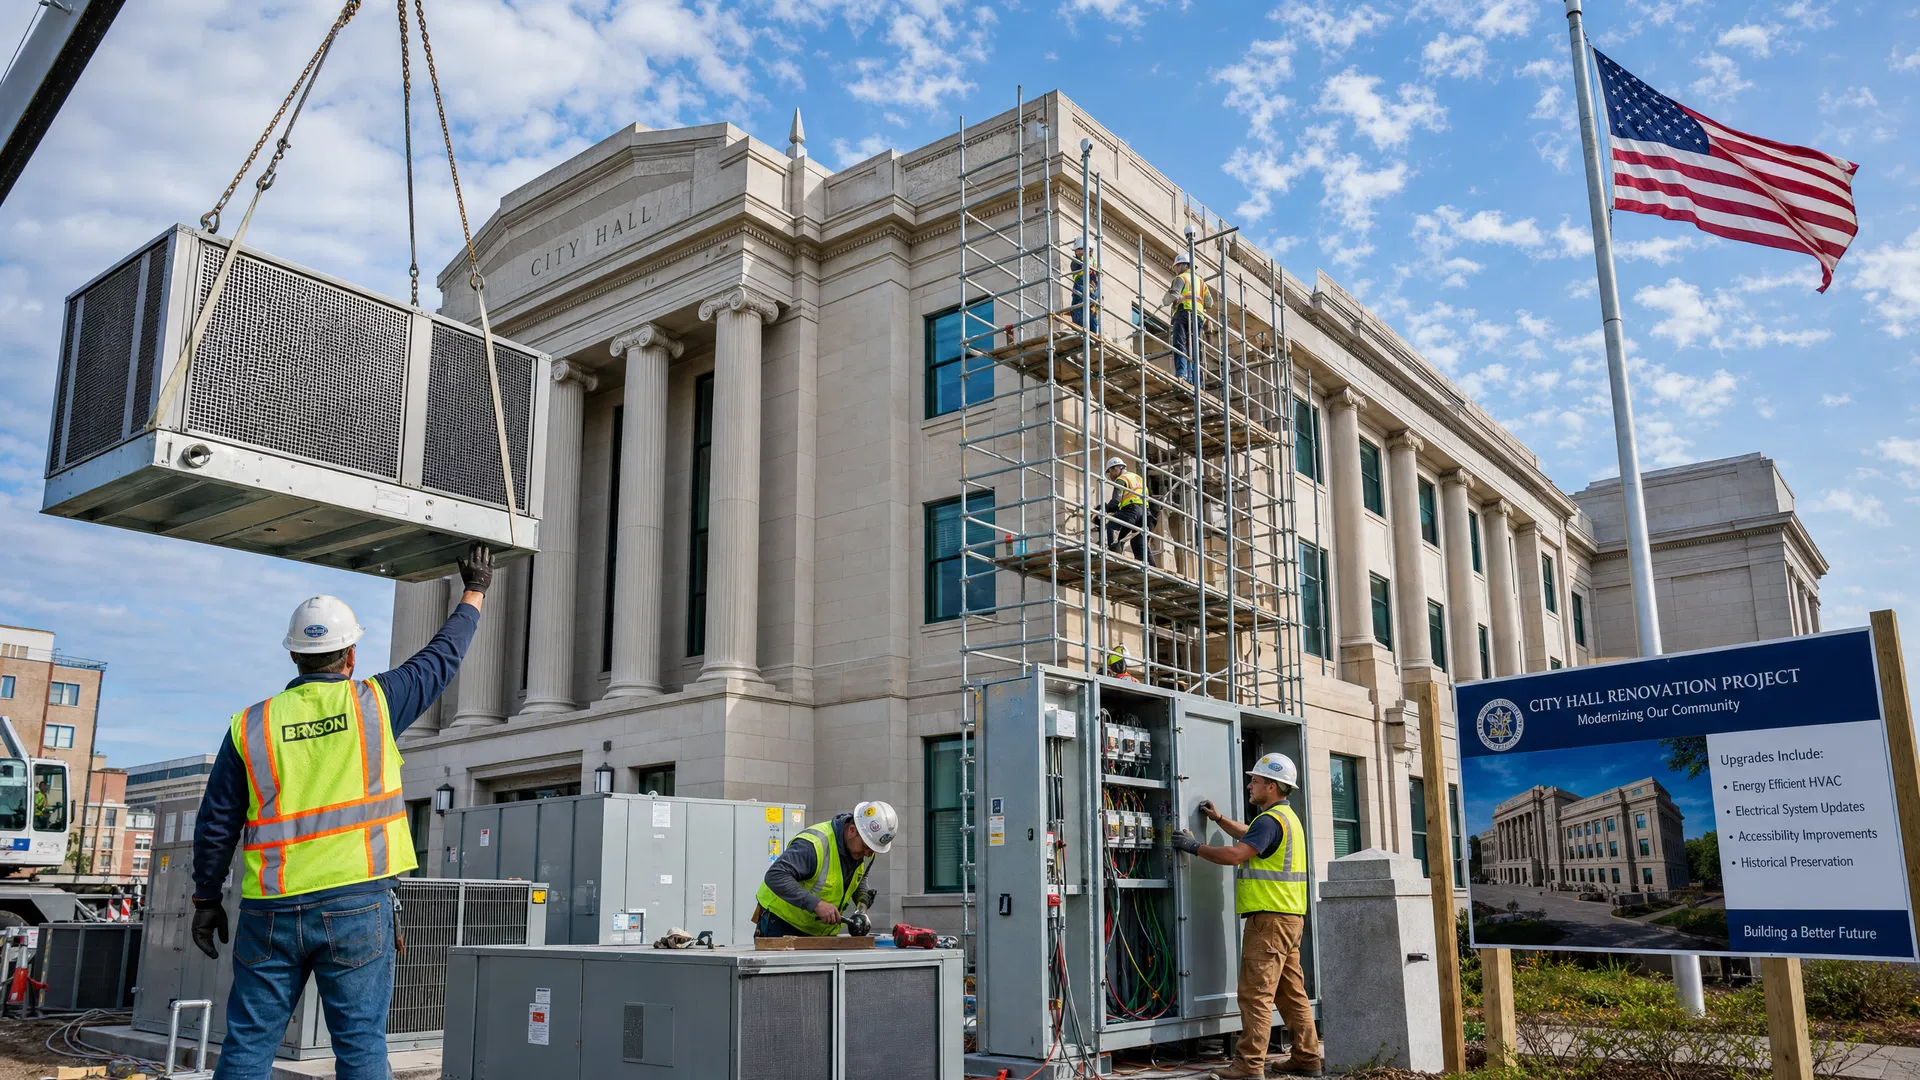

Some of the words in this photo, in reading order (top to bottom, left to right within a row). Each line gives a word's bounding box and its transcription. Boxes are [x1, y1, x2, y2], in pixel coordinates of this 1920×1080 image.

[531, 238, 580, 276] CITY
[595, 206, 652, 246] HALL
[1529, 696, 1562, 713] CITY
[1566, 692, 1604, 709] HALL
[1607, 678, 1717, 703] RENOVATION
[1722, 668, 1800, 691] PROJECT
[1577, 708, 1644, 726] Modernizing
[1647, 707, 1669, 719] Our
[1672, 699, 1740, 717] Community
[284, 716, 345, 740] BRYSON
[1720, 751, 1775, 768] Upgrades
[1778, 748, 1824, 762] Include:
[1732, 781, 1766, 793] Energy
[1768, 778, 1806, 790] Efficient
[1809, 775, 1842, 788] HVAC
[1735, 805, 1779, 816] Electrical
[1782, 803, 1818, 817] System
[1820, 801, 1865, 815] Updates
[1738, 830, 1799, 843] Accessibility
[1803, 828, 1878, 843] Improvements
[1741, 856, 1787, 868] Historical
[1790, 855, 1854, 867] Preservation
[1744, 925, 1788, 941] Building
[1790, 929, 1798, 938] a
[1801, 926, 1836, 938] Better
[1838, 926, 1877, 939] Future
